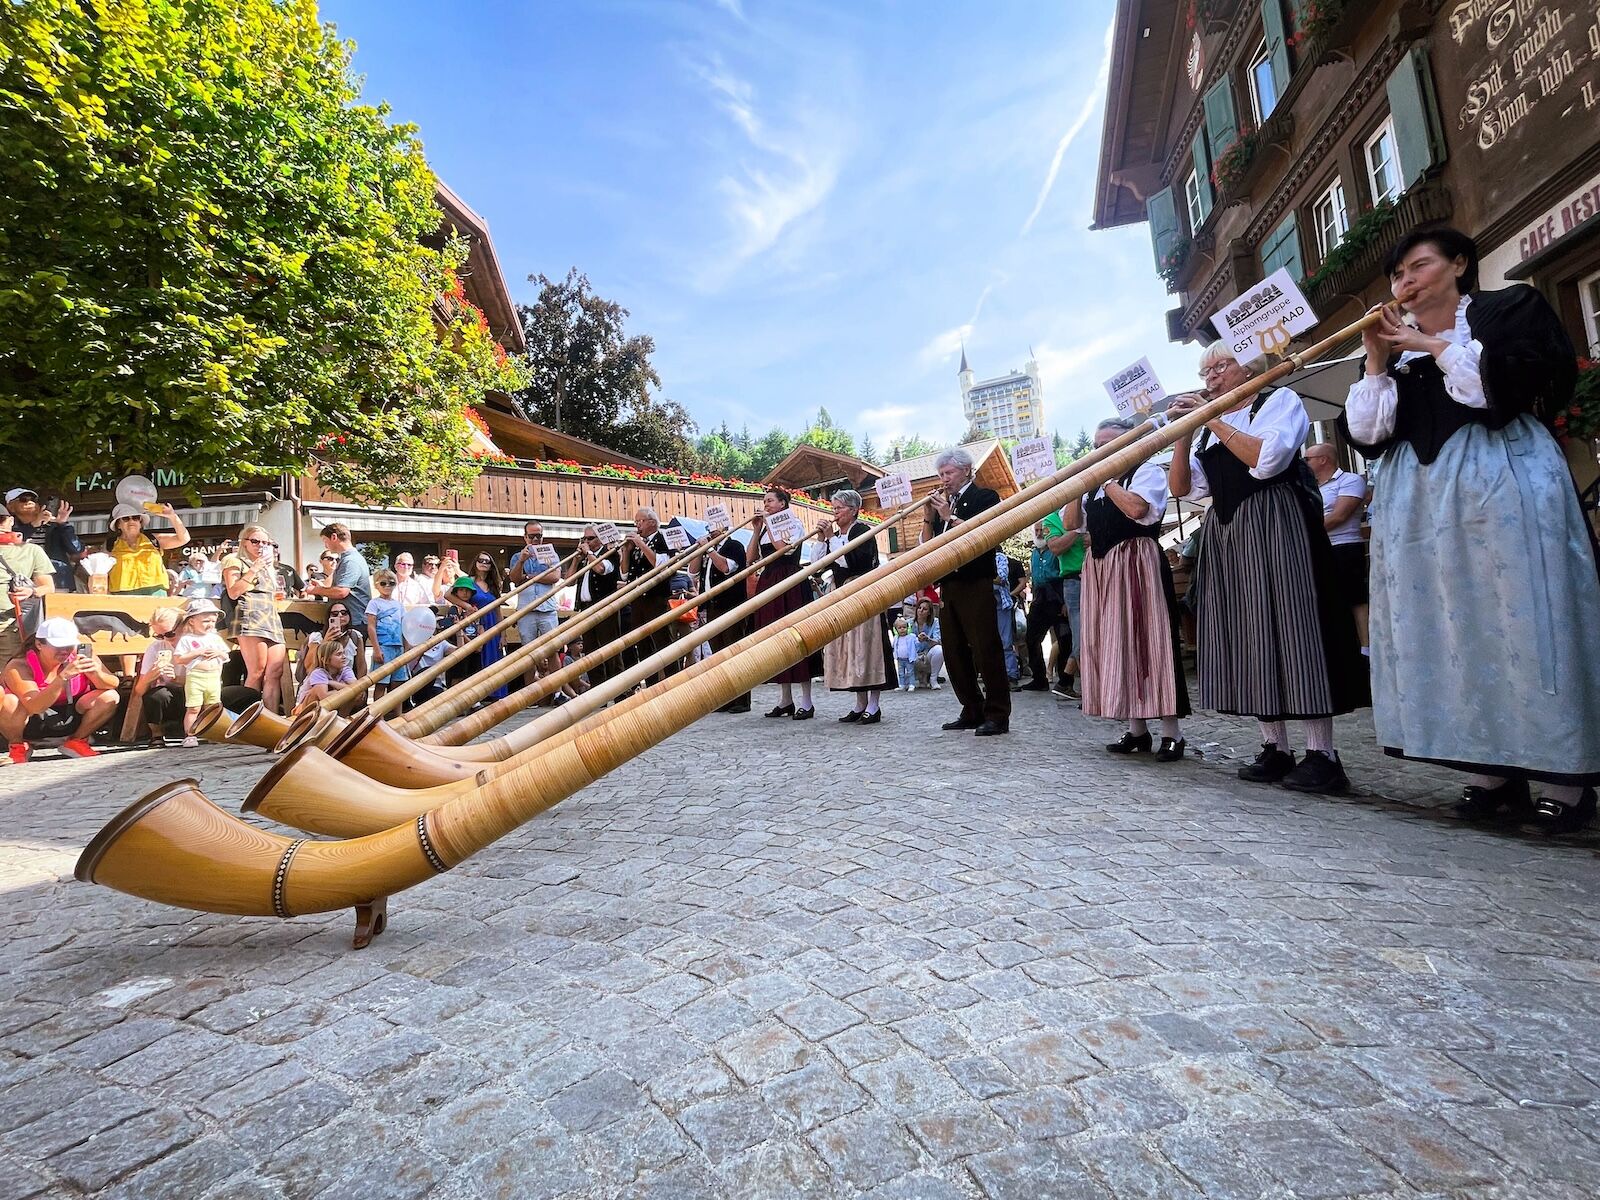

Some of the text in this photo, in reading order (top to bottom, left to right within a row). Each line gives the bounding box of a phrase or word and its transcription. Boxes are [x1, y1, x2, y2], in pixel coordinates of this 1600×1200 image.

[1232, 298, 1291, 338] Alphorngruppe
[1233, 305, 1305, 354] GST AAD
[1116, 383, 1160, 411] GST AAD
[182, 545, 228, 556] CHAN
